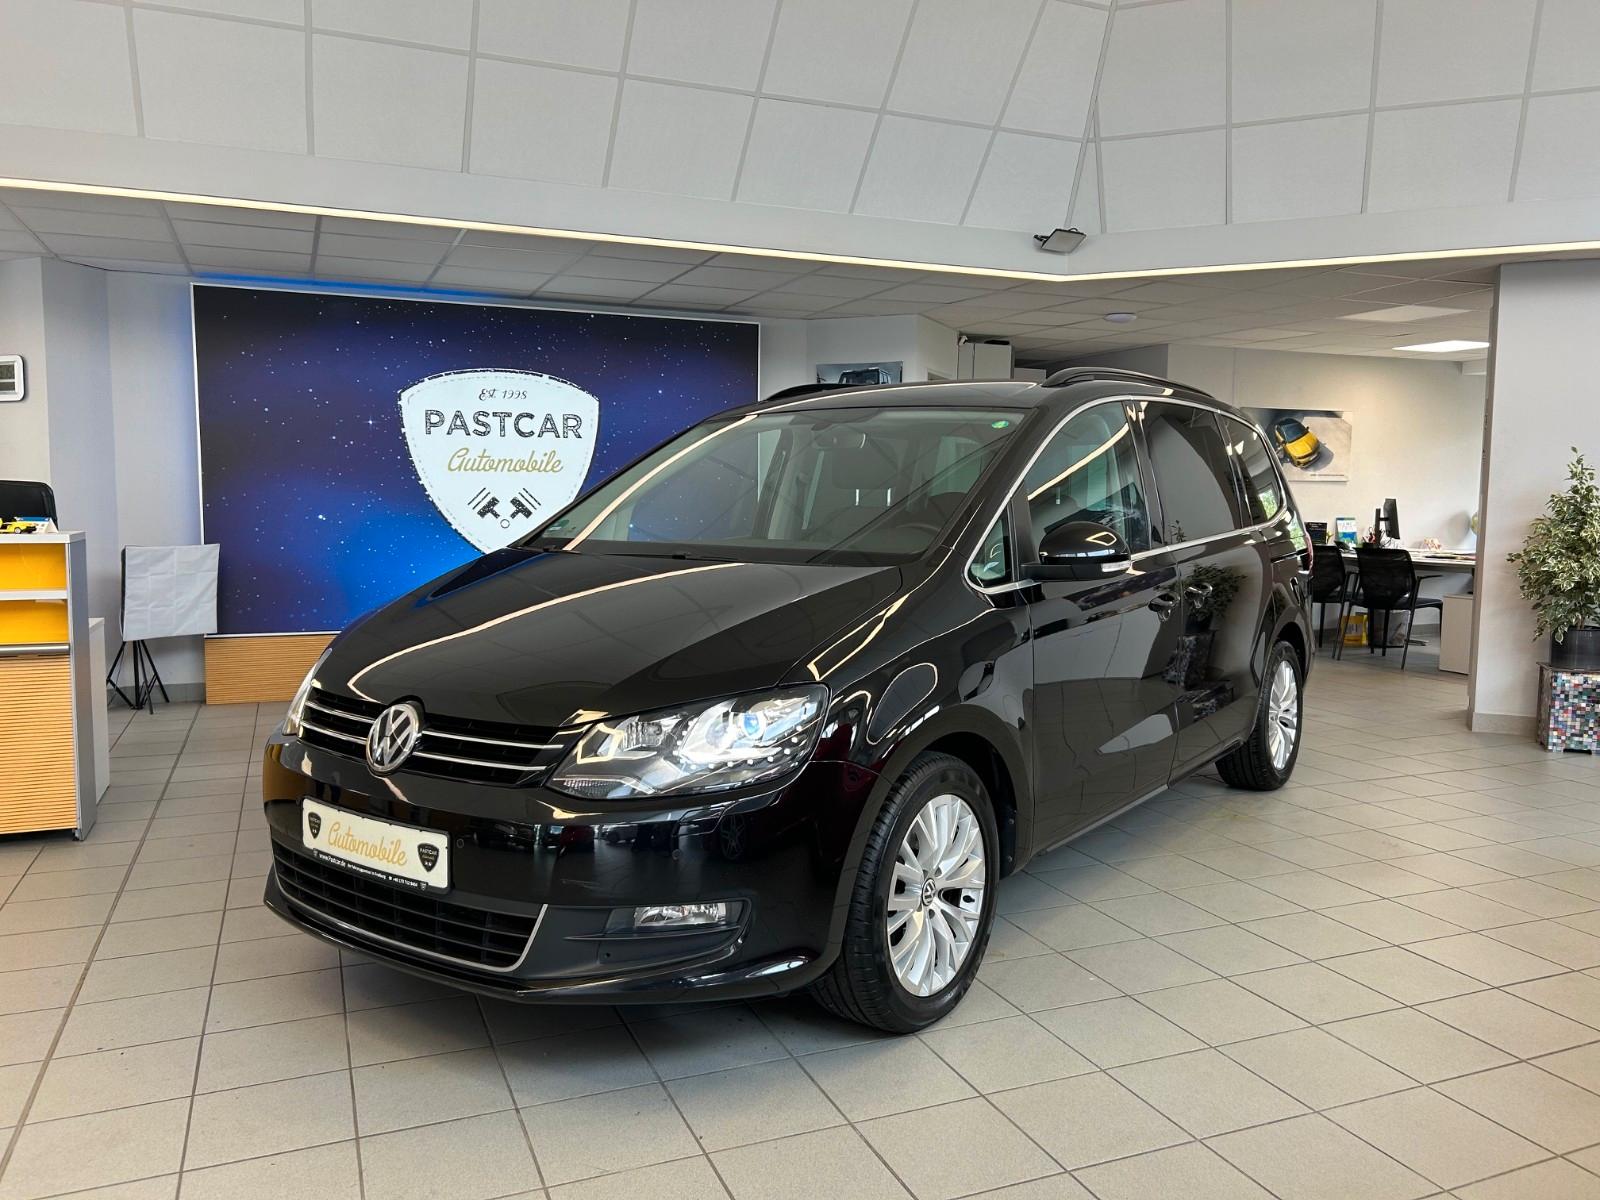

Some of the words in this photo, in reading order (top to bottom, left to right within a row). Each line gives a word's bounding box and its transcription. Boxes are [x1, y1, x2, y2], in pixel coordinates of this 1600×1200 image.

[502, 389, 528, 400] 1998
[424, 409, 583, 439] PASTCAR
[447, 447, 564, 473] Automobile
[327, 821, 408, 867] Automobile
